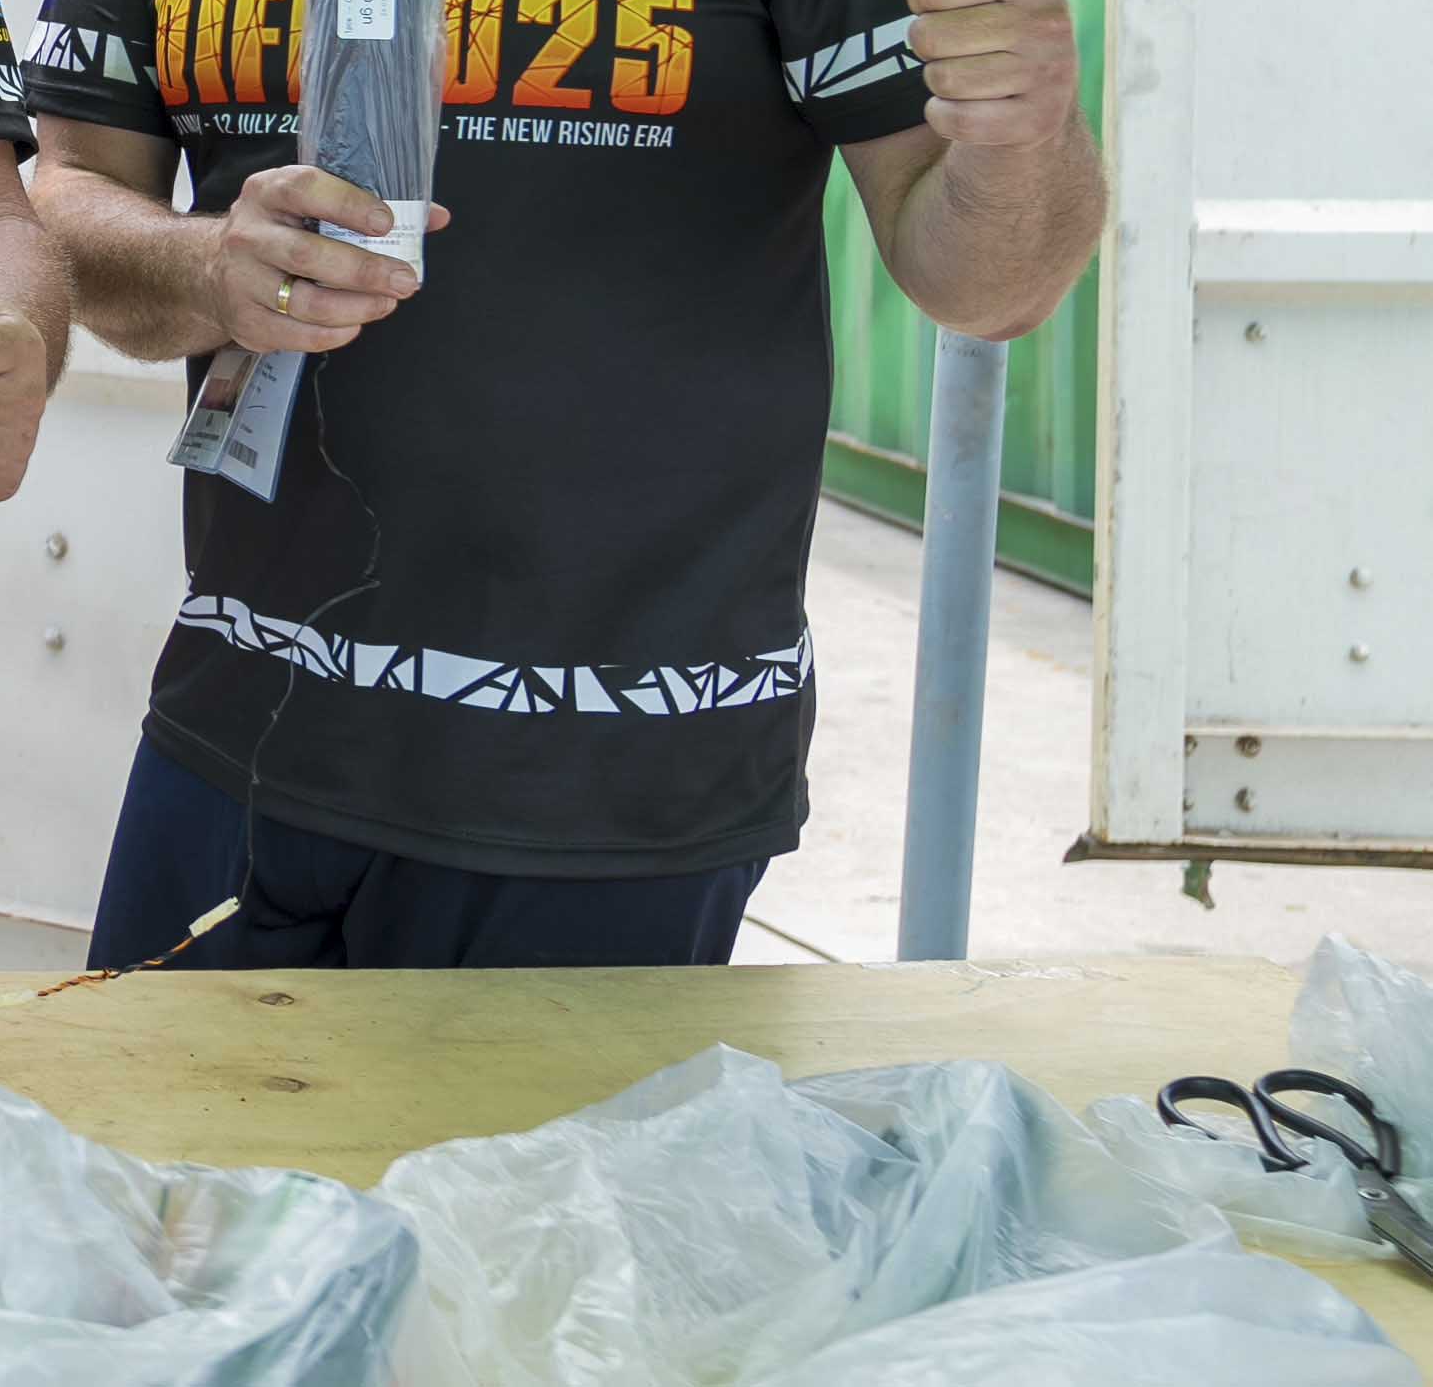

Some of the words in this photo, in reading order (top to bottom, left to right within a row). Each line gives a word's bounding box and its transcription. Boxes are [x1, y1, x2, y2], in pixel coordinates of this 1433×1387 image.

[359, 7, 373, 25] u6
[213, 113, 235, 134] 12
[237, 113, 277, 134] JULY
[456, 116, 497, 141] THE
[501, 117, 553, 144] NEW
[558, 120, 630, 147] RISING
[634, 124, 674, 148] ERA
